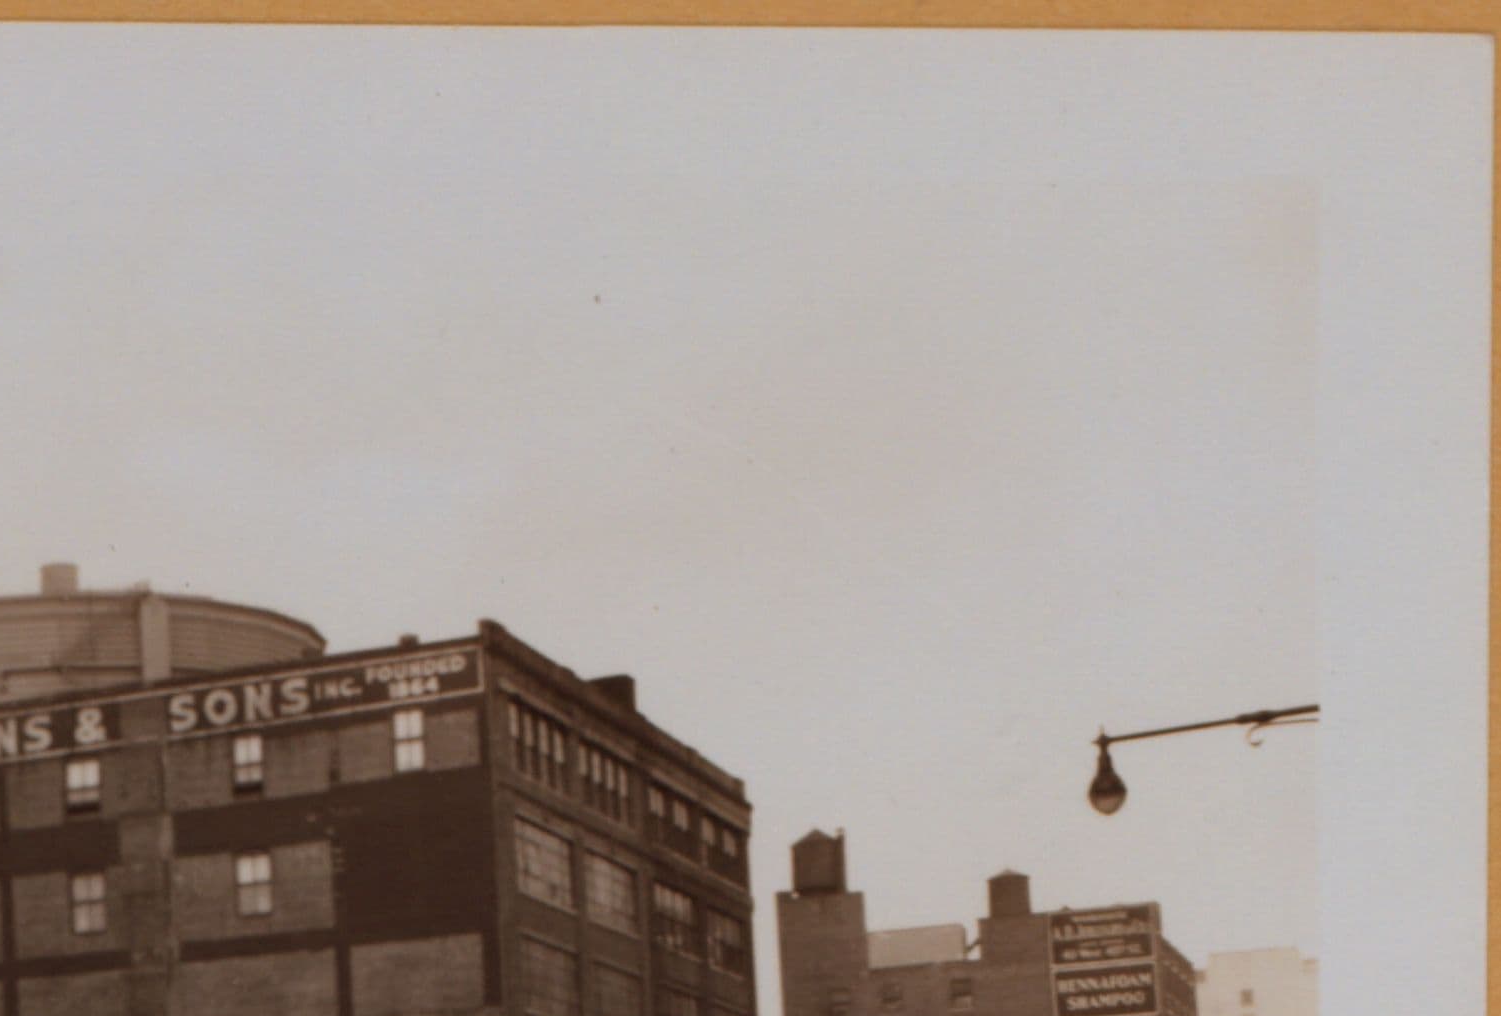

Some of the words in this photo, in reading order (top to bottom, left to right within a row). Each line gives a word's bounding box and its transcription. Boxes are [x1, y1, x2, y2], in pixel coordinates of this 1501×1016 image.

[365, 654, 467, 685] FOUNDED
[74, 707, 107, 745] &
[168, 677, 312, 733] SONS
[314, 677, 362, 700] INC.
[1066, 991, 1146, 1011] SHAMPOO
